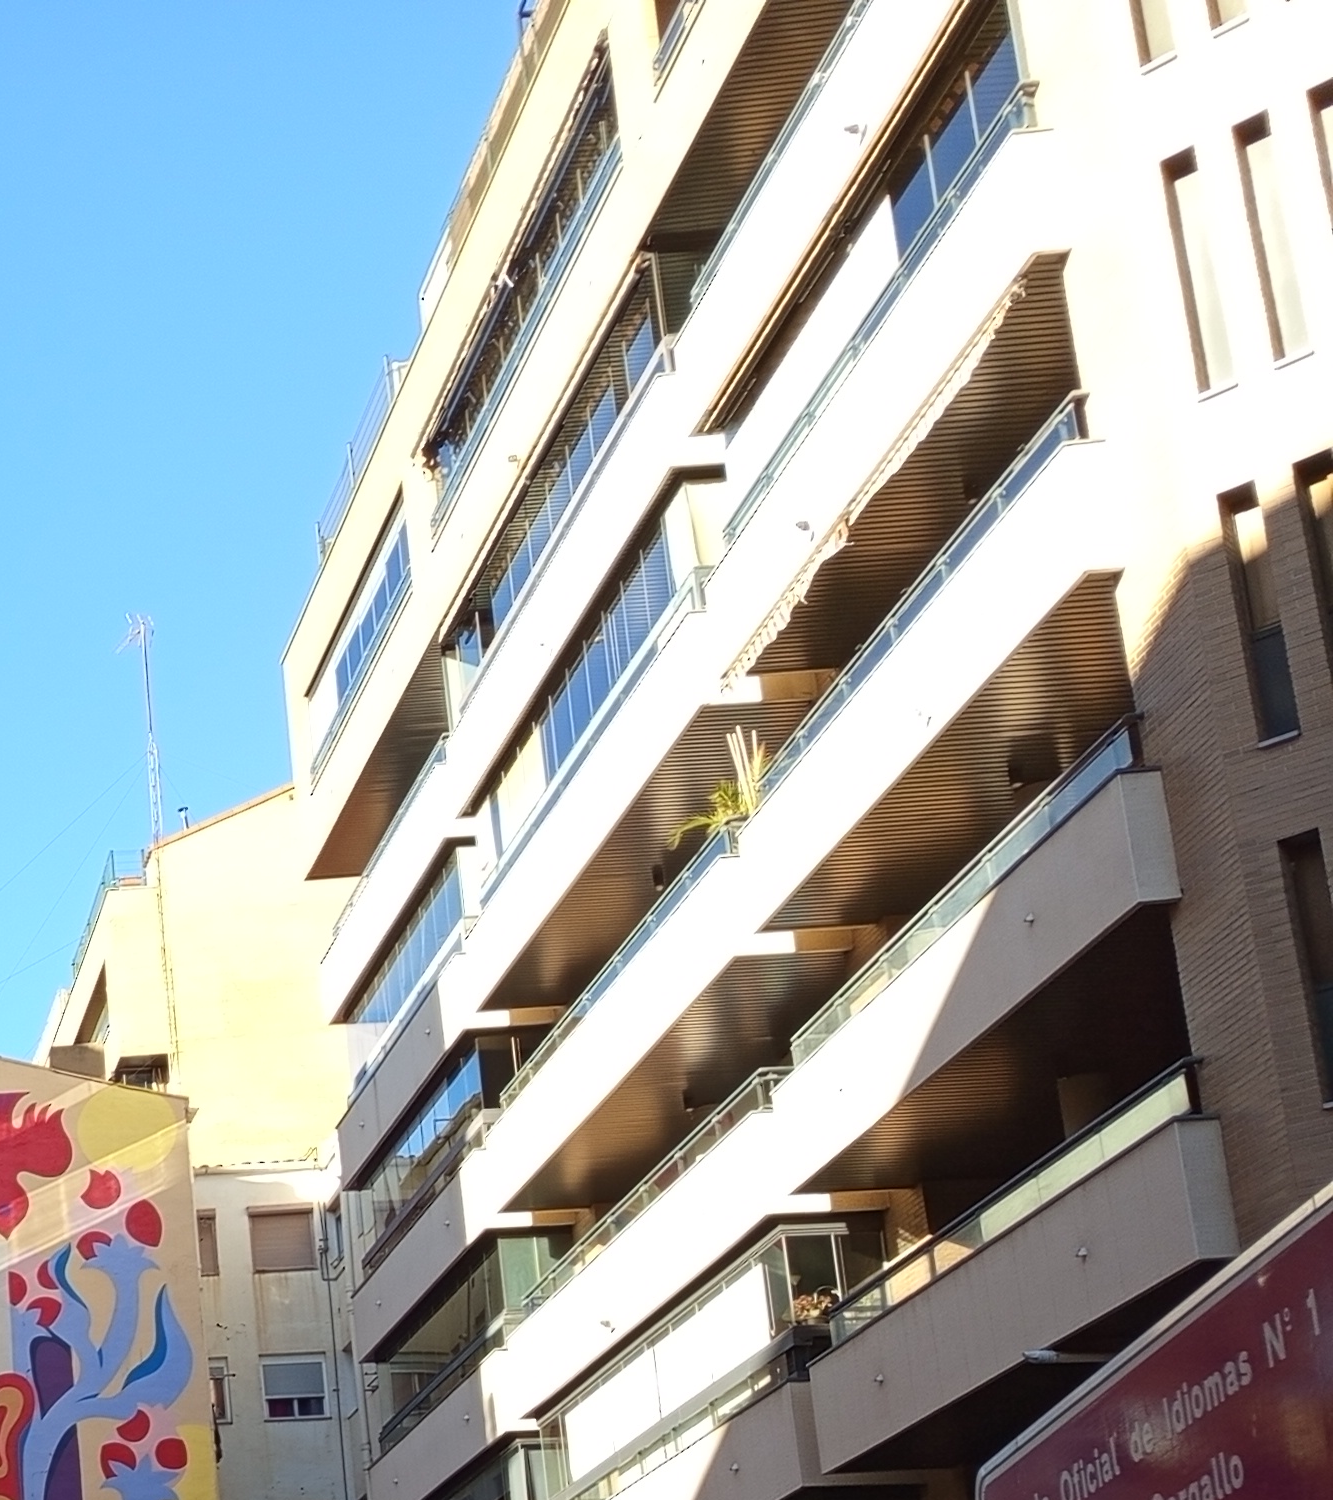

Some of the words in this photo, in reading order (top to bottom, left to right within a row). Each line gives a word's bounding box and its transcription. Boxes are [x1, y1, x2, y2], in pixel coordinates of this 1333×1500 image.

[1130, 1421, 1153, 1462] de
[1162, 1351, 1252, 1439] Idiomas
[1262, 1307, 1293, 1368] Nº
[1306, 1288, 1321, 1336] 1
